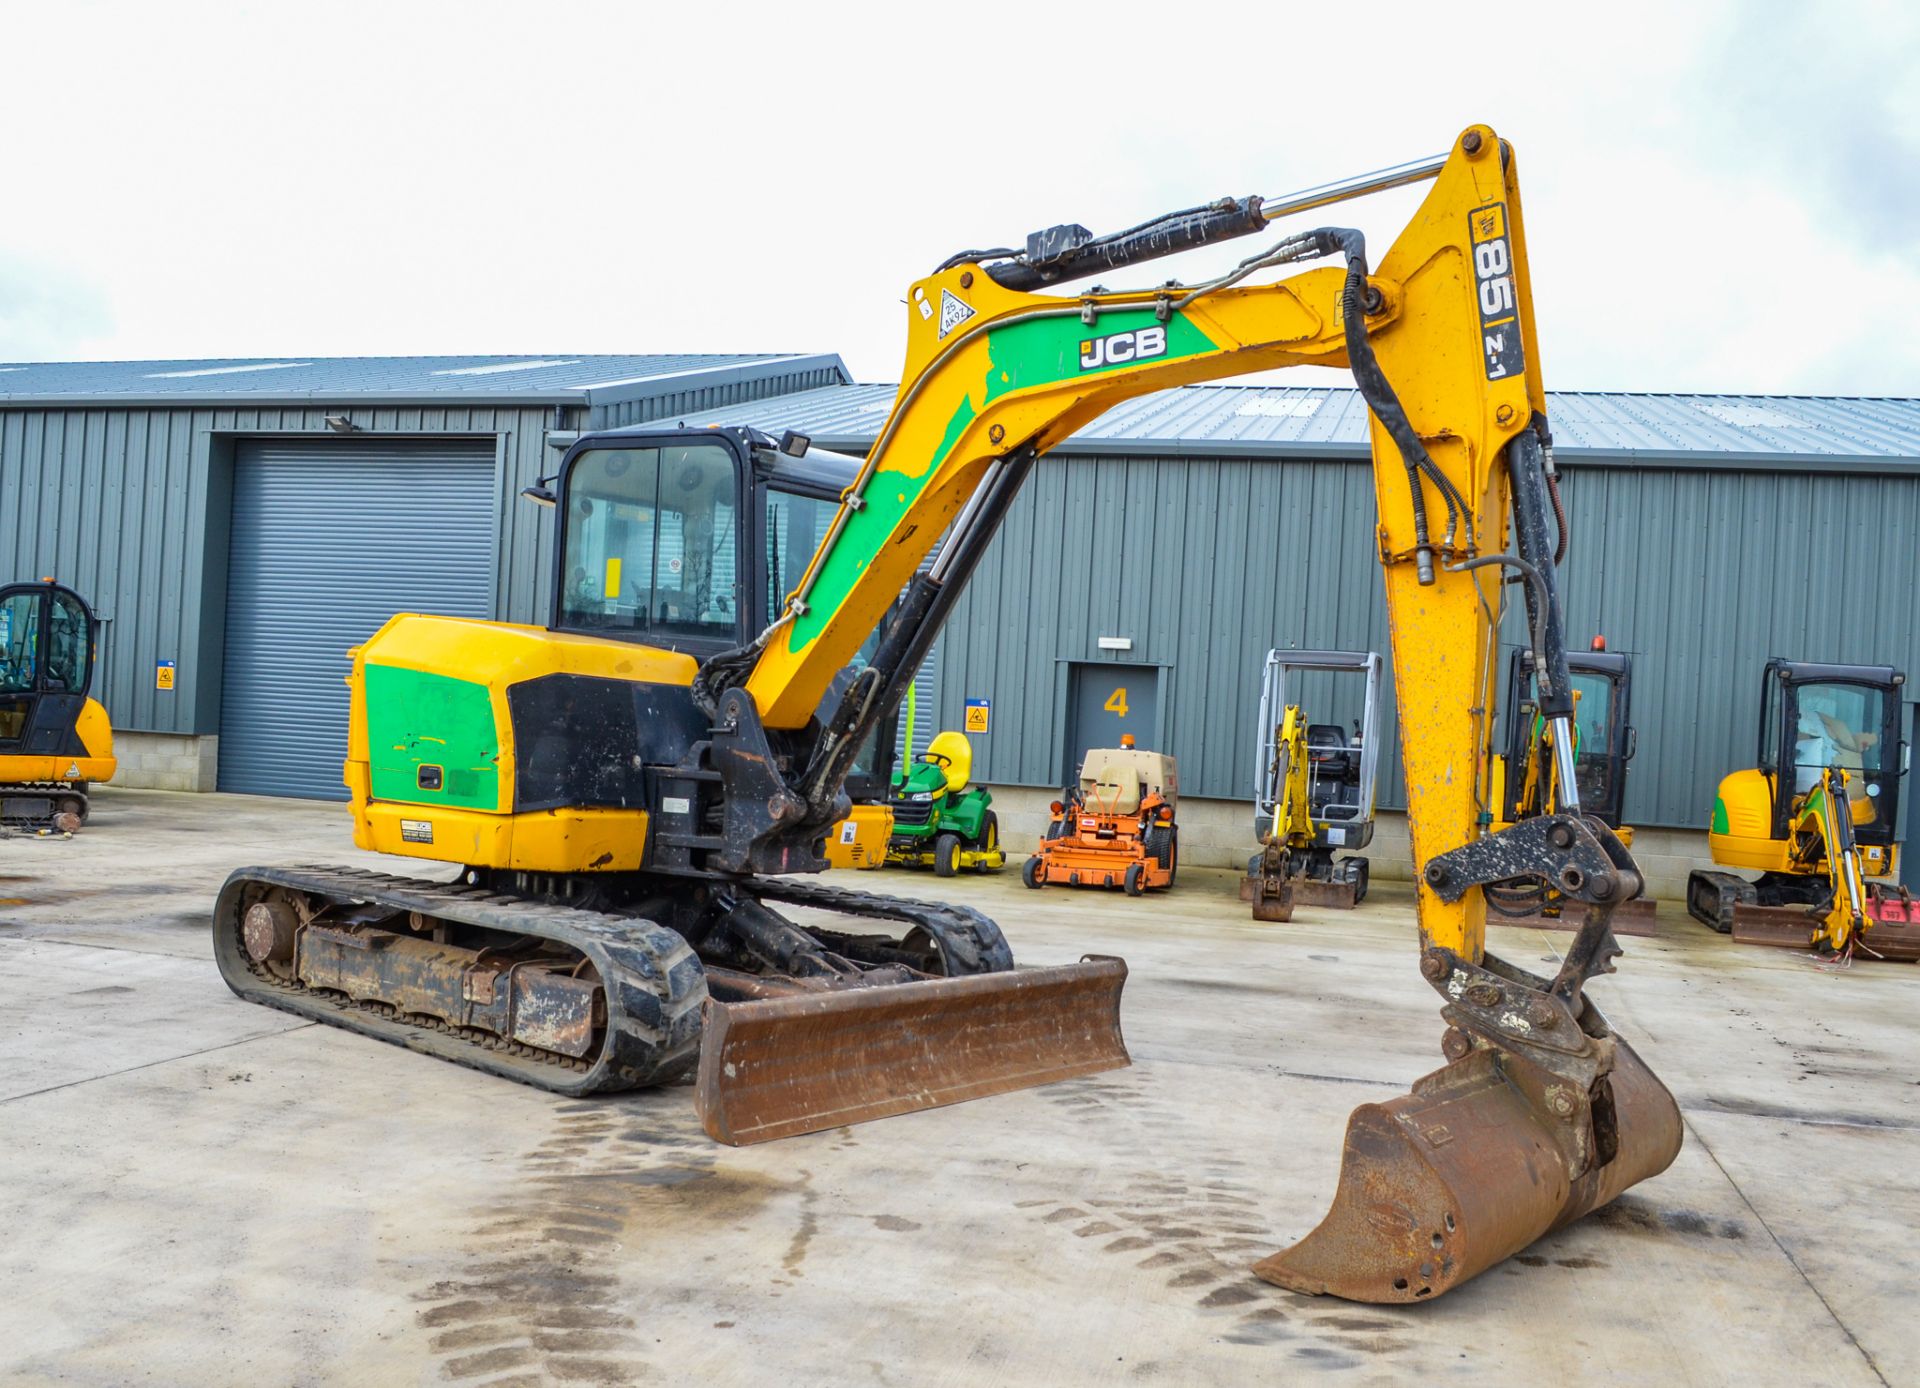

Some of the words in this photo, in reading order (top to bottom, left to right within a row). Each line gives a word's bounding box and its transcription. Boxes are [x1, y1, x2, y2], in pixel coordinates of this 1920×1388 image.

[1475, 239, 1513, 316] 85
[945, 301, 957, 315] 25
[945, 307, 967, 329] AK9Z
[1081, 326, 1166, 368] JCB
[1484, 333, 1507, 379] Z-1
[1104, 687, 1129, 718] 4
